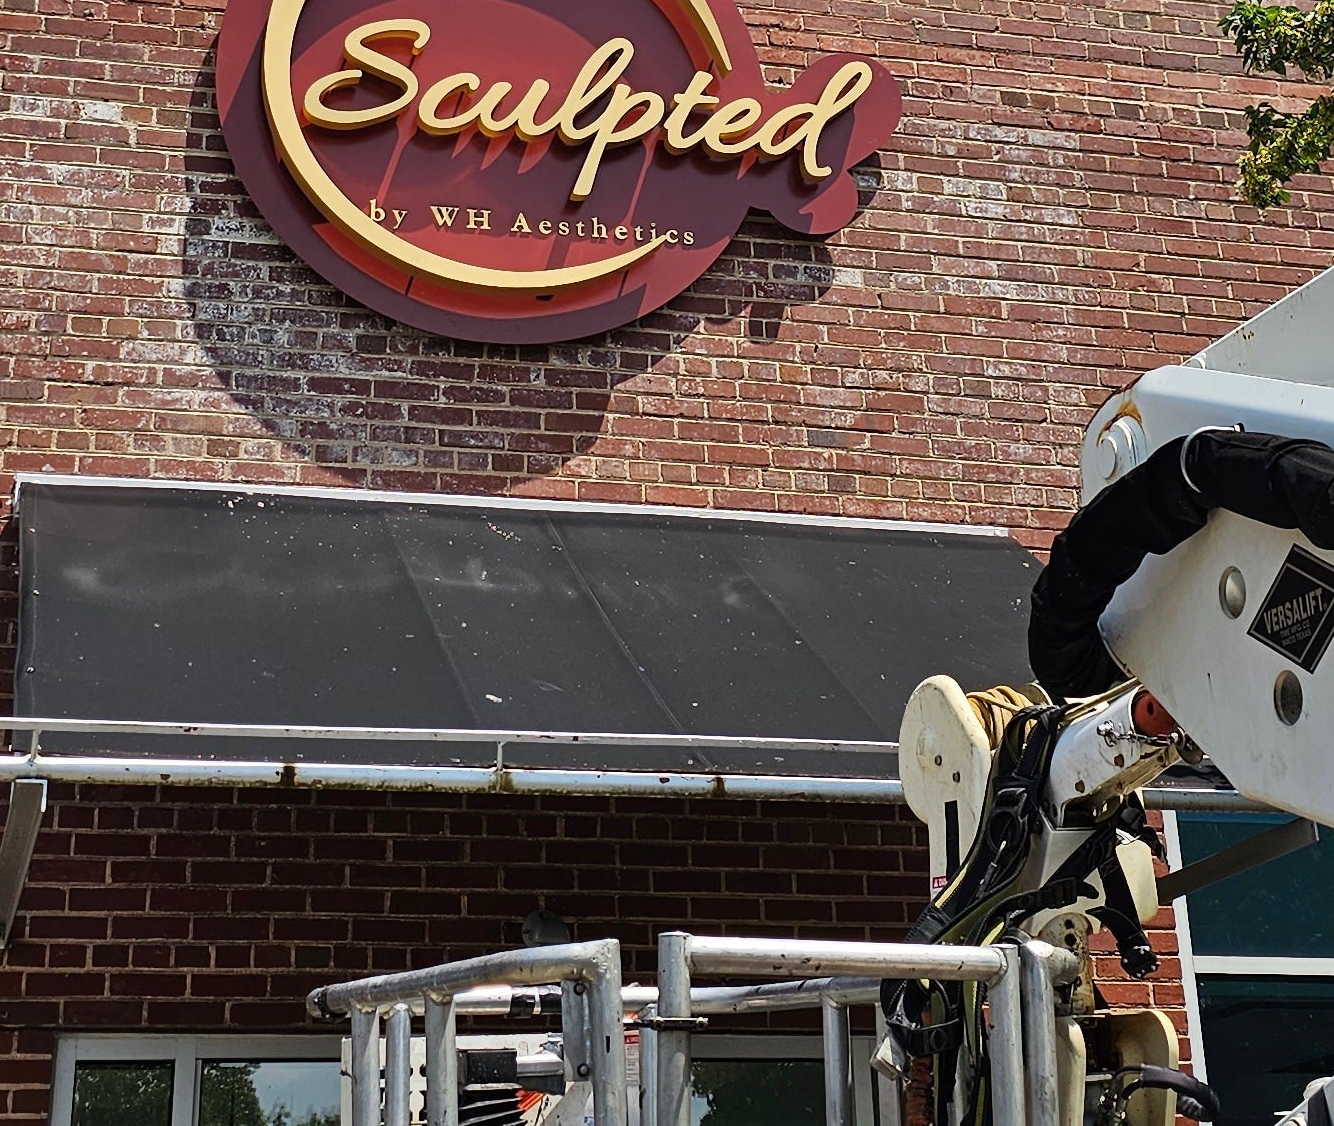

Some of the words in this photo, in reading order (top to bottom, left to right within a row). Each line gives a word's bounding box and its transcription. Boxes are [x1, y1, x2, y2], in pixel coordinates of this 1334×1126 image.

[303, 19, 873, 201] Sculpted
[369, 199, 407, 229] by
[430, 205, 492, 230] WH
[511, 212, 695, 245] Aesthetics
[1263, 587, 1323, 634] VERSALIFT
